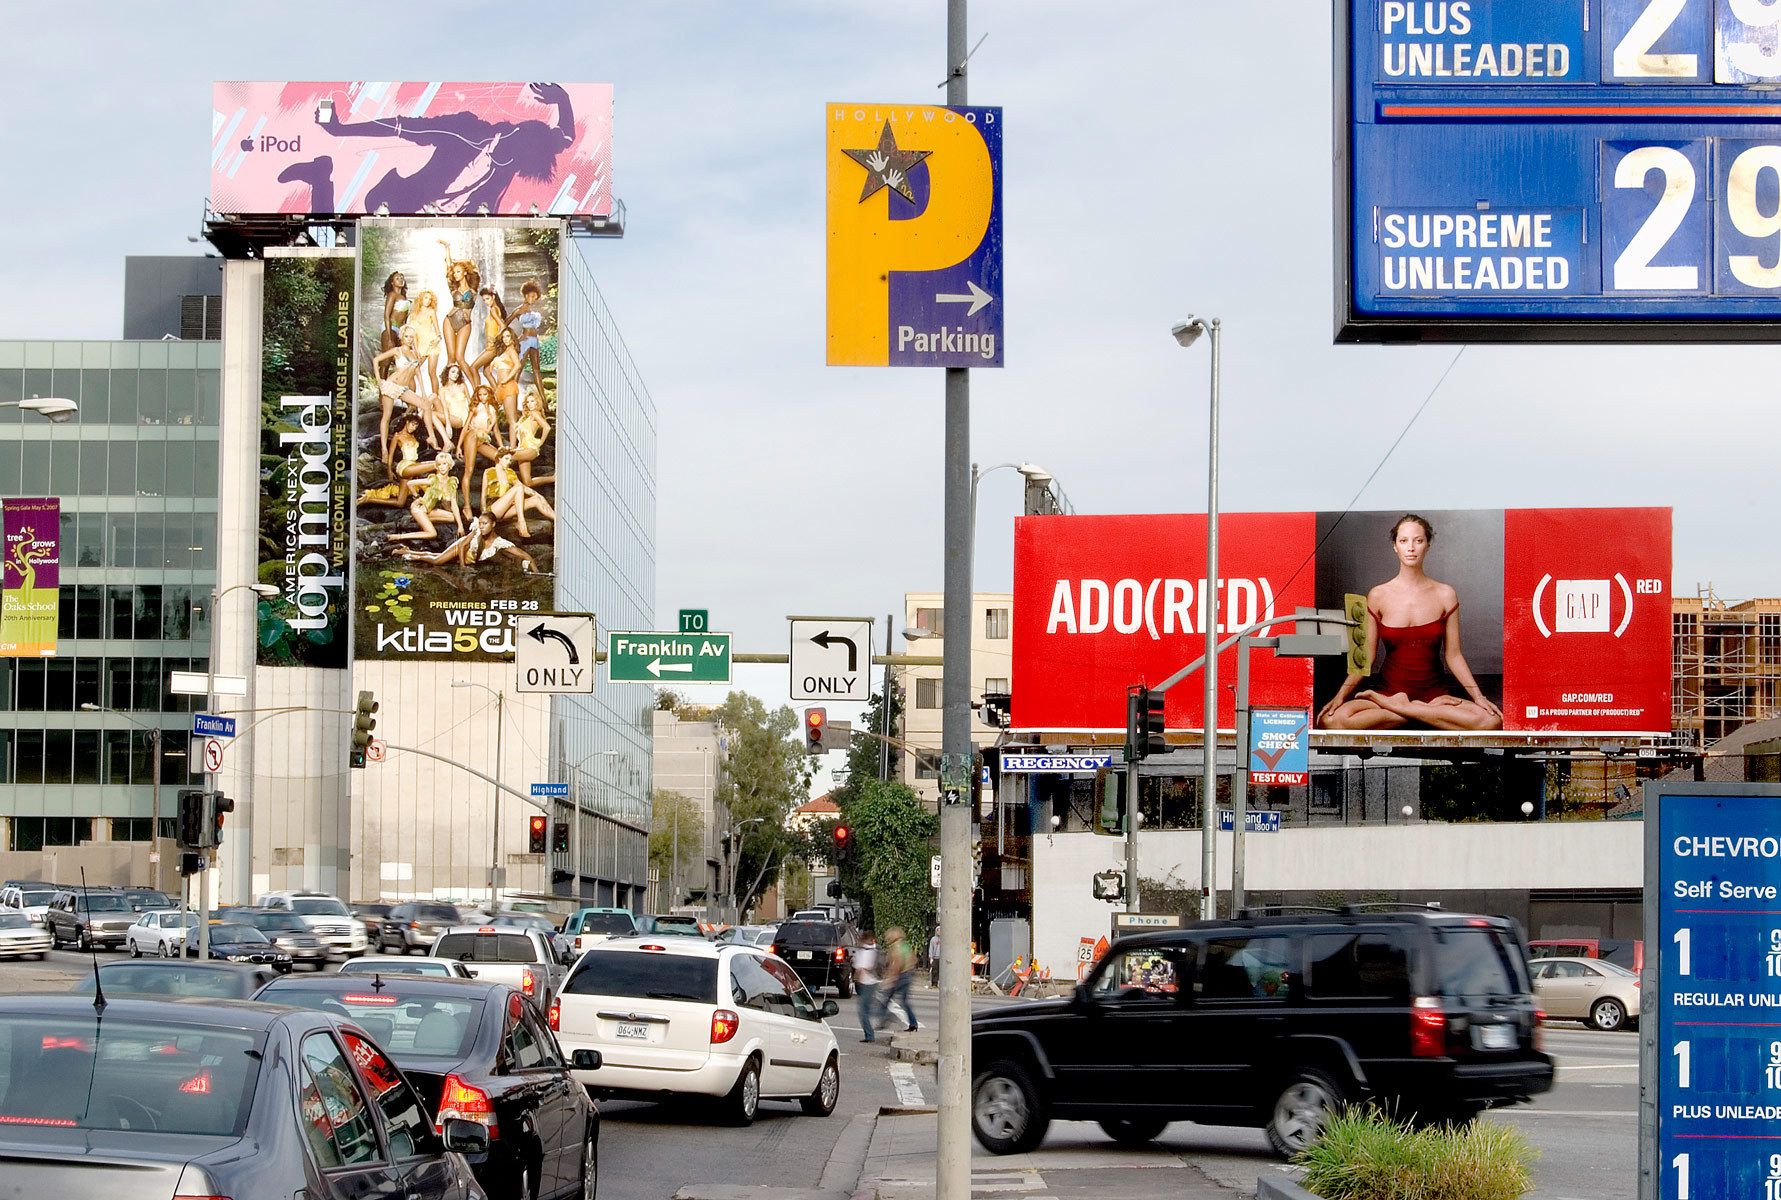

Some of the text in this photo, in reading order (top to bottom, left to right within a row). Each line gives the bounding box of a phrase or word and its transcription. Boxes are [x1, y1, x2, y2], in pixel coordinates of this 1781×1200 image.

[1384, 1, 1472, 35] PLUS
[1383, 43, 1570, 77] UNLEADED
[835, 109, 994, 124] HOLLYWOOD
[261, 135, 301, 152] iPod
[1384, 214, 1552, 249] SUPREME
[1384, 256, 1570, 290] UNLEADED
[898, 325, 995, 359] Parking
[333, 291, 349, 567] WELCOME TO THE JUNGLE, LADIES
[20, 526, 27, 534] A
[285, 455, 298, 605] AMERICA'S NEXT
[7, 534, 24, 542] tree
[31, 541, 56, 550] grows
[28, 557, 59, 566] Hollywood
[1636, 579, 1662, 594] RED
[3, 602, 56, 611] Oaks School
[4, 595, 19, 603] The
[490, 600, 518, 610] FEB
[521, 600, 539, 611] 28
[445, 610, 503, 627] WED
[682, 614, 704, 630] TO
[617, 639, 725, 657] Franklin Av
[526, 668, 584, 687] ONLY
[803, 676, 857, 694] ONLY
[1561, 693, 1614, 703] GAP.COM/RED
[196, 718, 234, 733] Franklin Av
[1261, 732, 1296, 741] SMOG
[1257, 741, 1300, 750] CHECK
[1006, 757, 1109, 769] REGENCY
[1253, 772, 1303, 784] TEST ONLY
[532, 786, 567, 796] Highland
[1269, 813, 1278, 821] Av
[1272, 823, 1277, 831] N
[1673, 836, 1781, 858] CHEVRO
[1673, 880, 1777, 899] Self Serve
[1129, 917, 1168, 925] Phone
[1080, 948, 1092, 960] 25
[1673, 928, 1691, 976] 1
[1673, 993, 1745, 1007] REGULAR
[1673, 1040, 1690, 1088] 1
[1673, 1105, 1712, 1119] PLUS
[1672, 1153, 1690, 1200] 1
